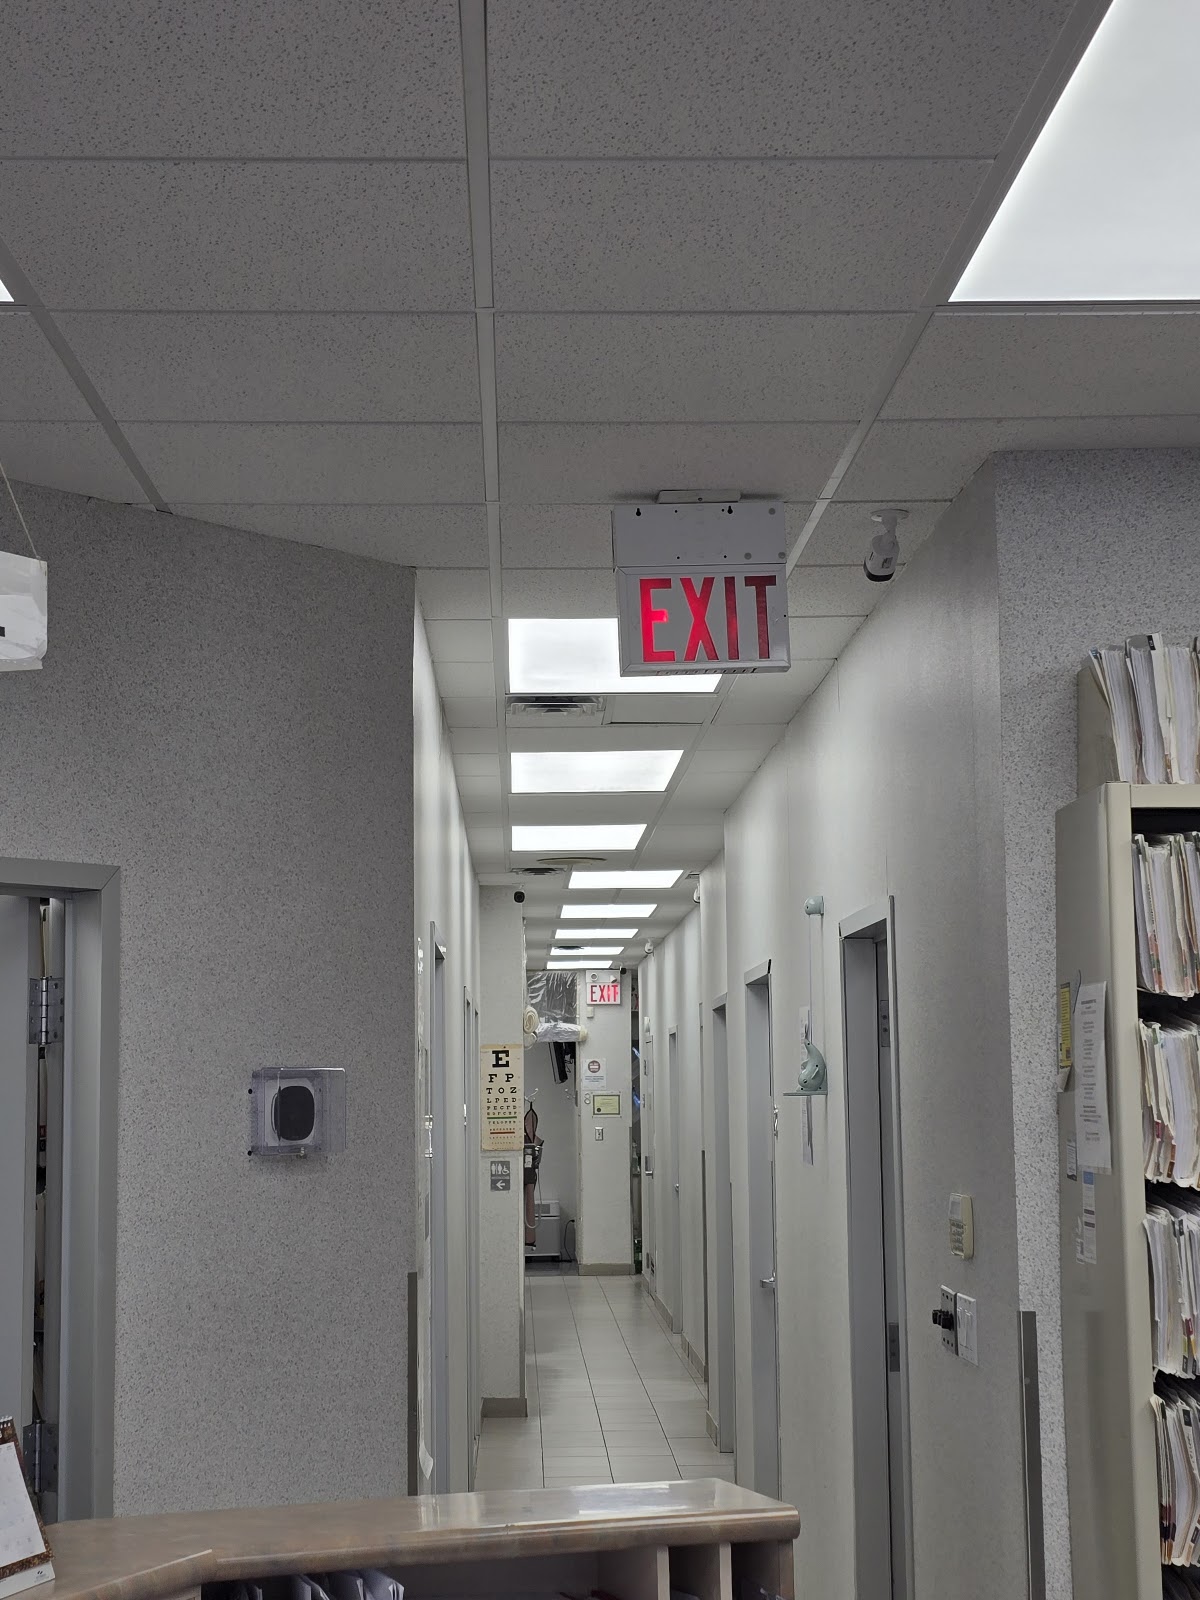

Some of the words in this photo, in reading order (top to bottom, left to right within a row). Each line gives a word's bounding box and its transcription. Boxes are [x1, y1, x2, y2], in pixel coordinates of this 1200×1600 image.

[639, 575, 777, 663] EXIT
[590, 984, 619, 1003] EXIT
[492, 1050, 509, 1068] E
